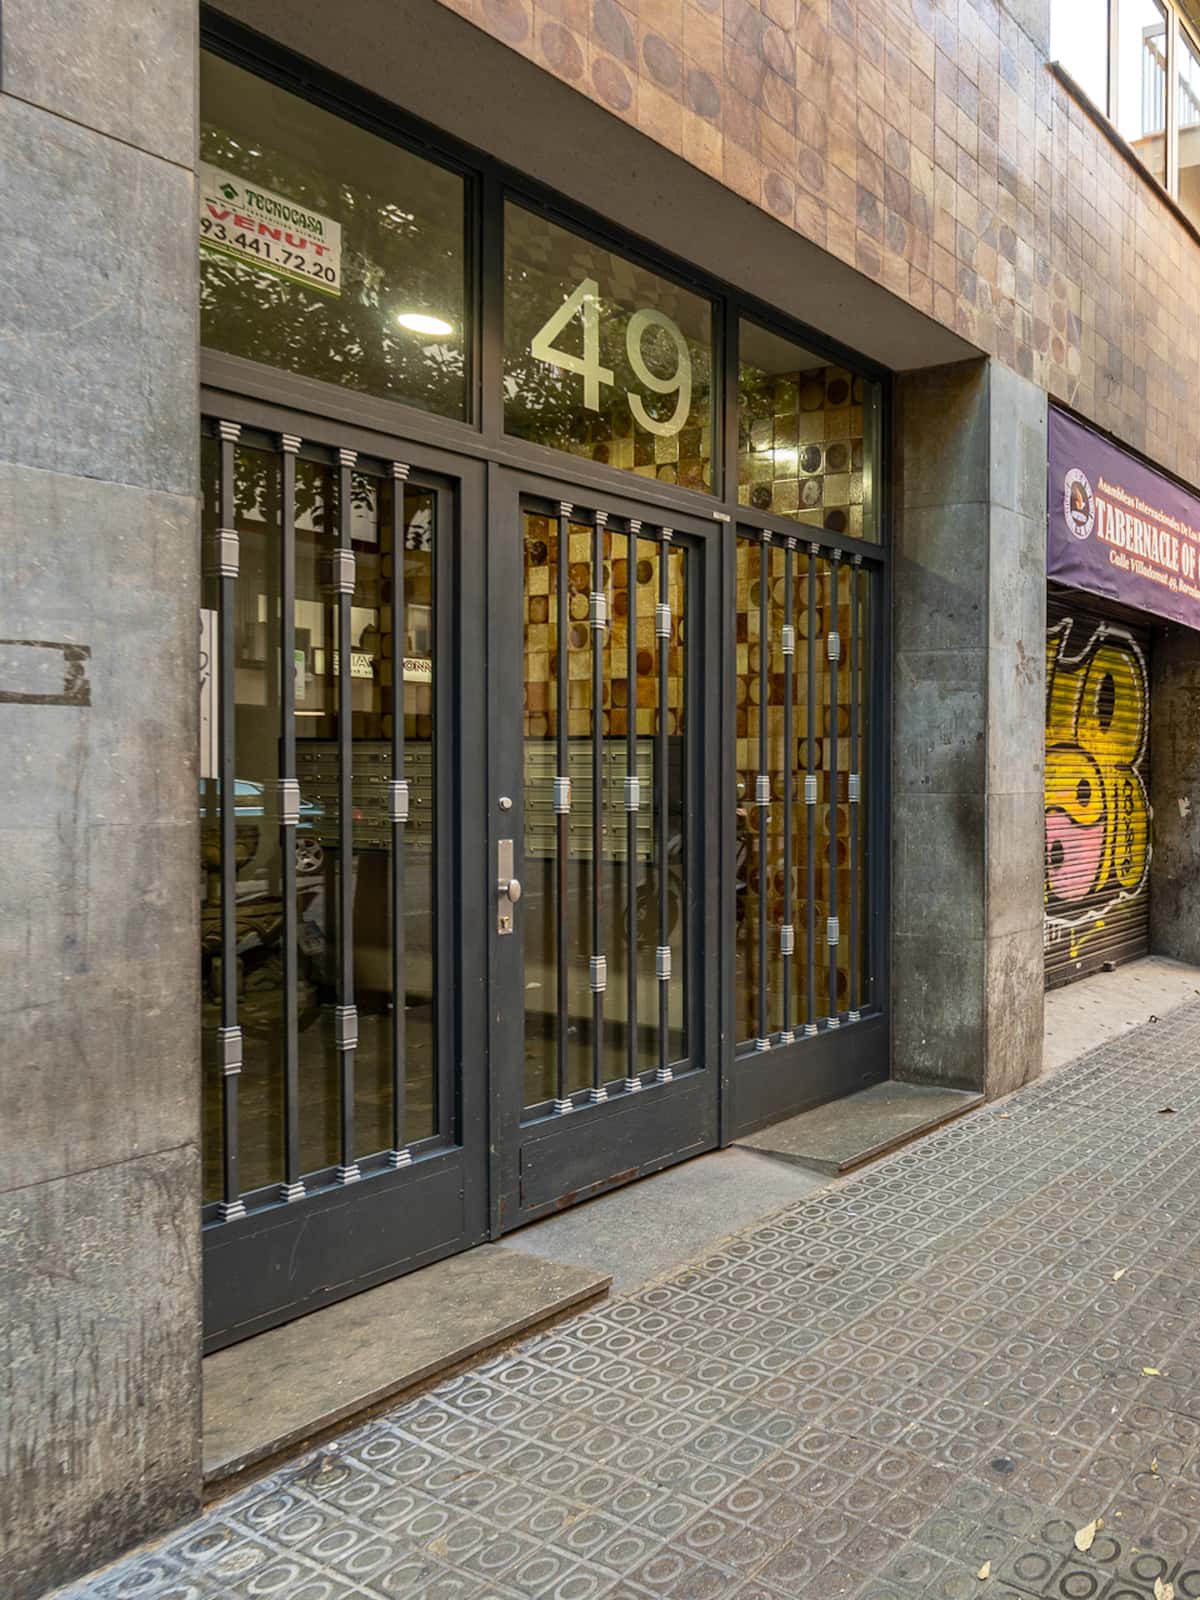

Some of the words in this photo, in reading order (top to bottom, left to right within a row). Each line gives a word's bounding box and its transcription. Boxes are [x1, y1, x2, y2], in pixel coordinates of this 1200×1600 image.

[206, 203, 331, 256] VENUT
[245, 188, 324, 236] TECNOCASA
[200, 217, 336, 282] 93.441.72.20
[531, 278, 692, 437] 49
[1096, 497, 1179, 572] TABERNACLE
[1181, 542, 1196, 579] OF
[1109, 550, 1129, 571] Calle
